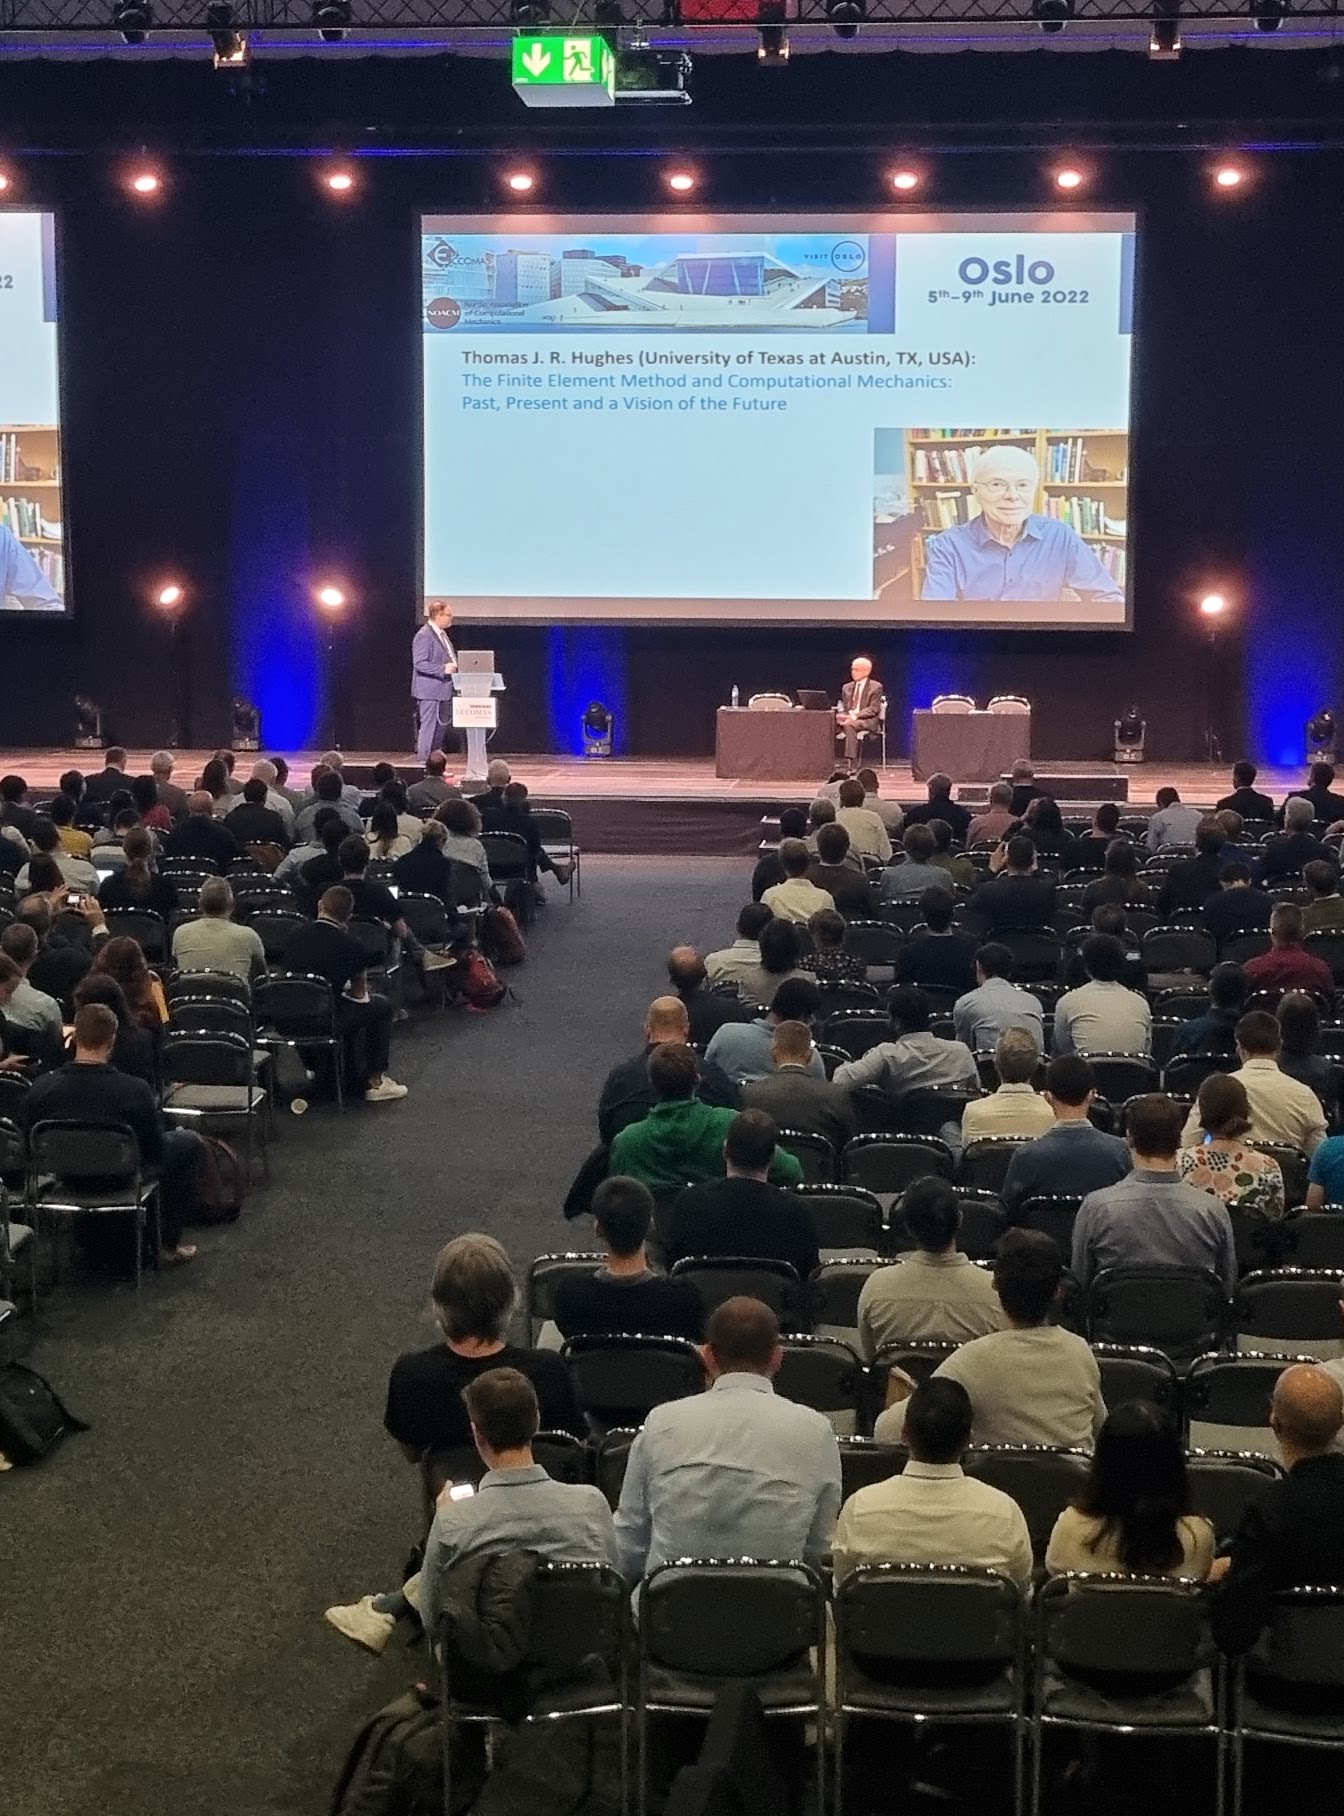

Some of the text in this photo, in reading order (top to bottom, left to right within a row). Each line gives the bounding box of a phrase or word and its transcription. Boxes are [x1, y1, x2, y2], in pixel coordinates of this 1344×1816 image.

[959, 255, 1054, 284] Oslo
[988, 291, 1034, 306] June
[1041, 290, 1089, 303] 2022
[461, 350, 975, 368] Thomas J. R. Hughes (University of Texas at Austin, TX, USA):
[461, 373, 951, 390] The Finite Element Method and Computational Mechanics:
[463, 396, 786, 411] Past, Present and a Vision of the Future
